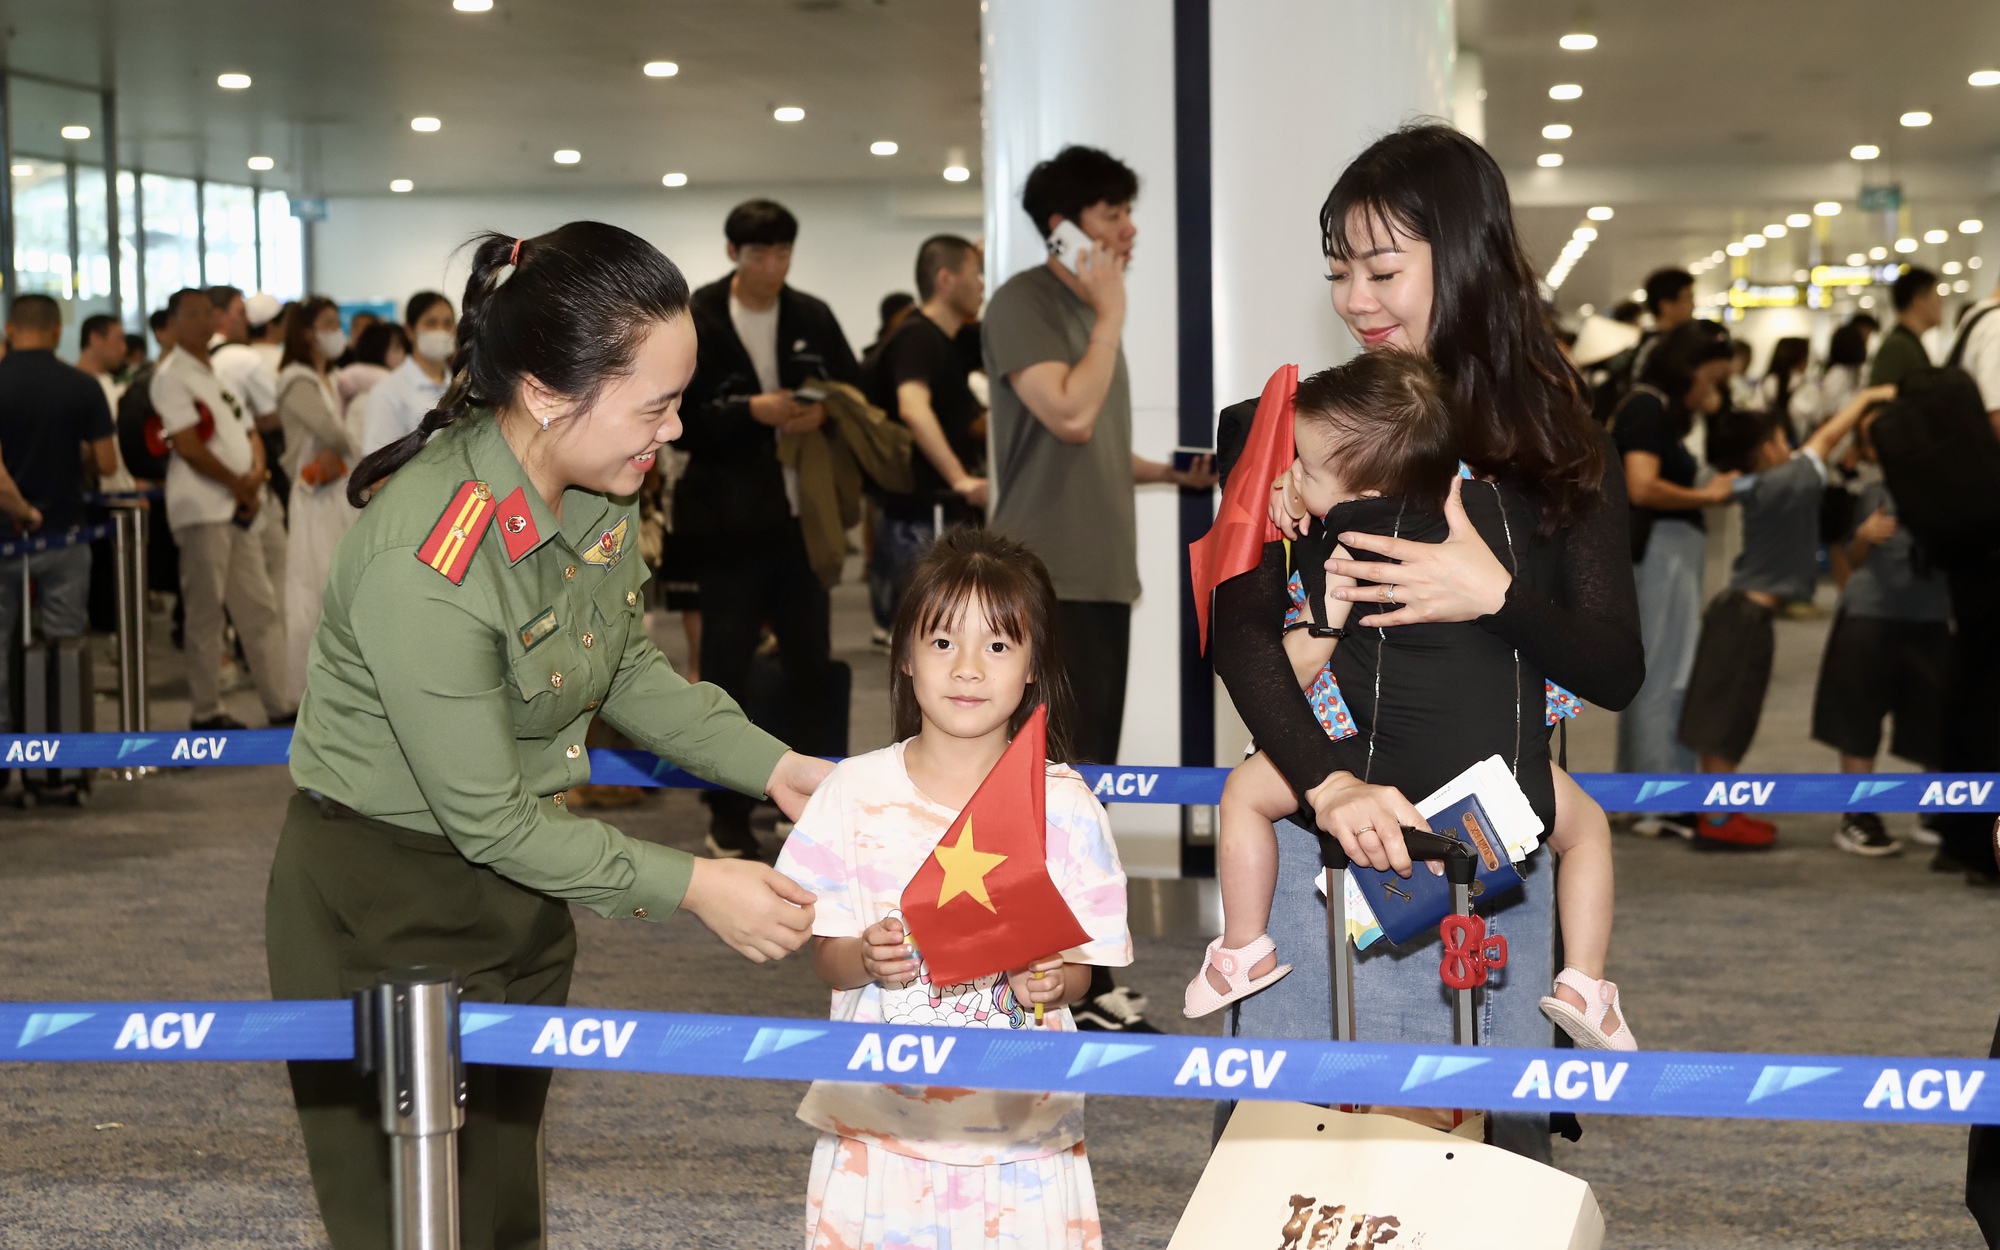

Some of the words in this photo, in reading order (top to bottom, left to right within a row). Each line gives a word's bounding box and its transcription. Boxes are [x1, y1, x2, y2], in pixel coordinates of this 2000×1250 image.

[5, 739, 60, 763] ACV
[172, 737, 228, 761] ACV
[1092, 772, 1159, 797] ACV
[1703, 781, 1776, 806] ACV
[1918, 781, 1994, 806] ACV
[114, 1012, 215, 1050] ACV
[531, 1017, 637, 1059] ACV
[847, 1032, 956, 1075] ACV
[1173, 1047, 1287, 1090] ACV
[1511, 1059, 1629, 1102] ACV
[1862, 1068, 1986, 1112] ACV
